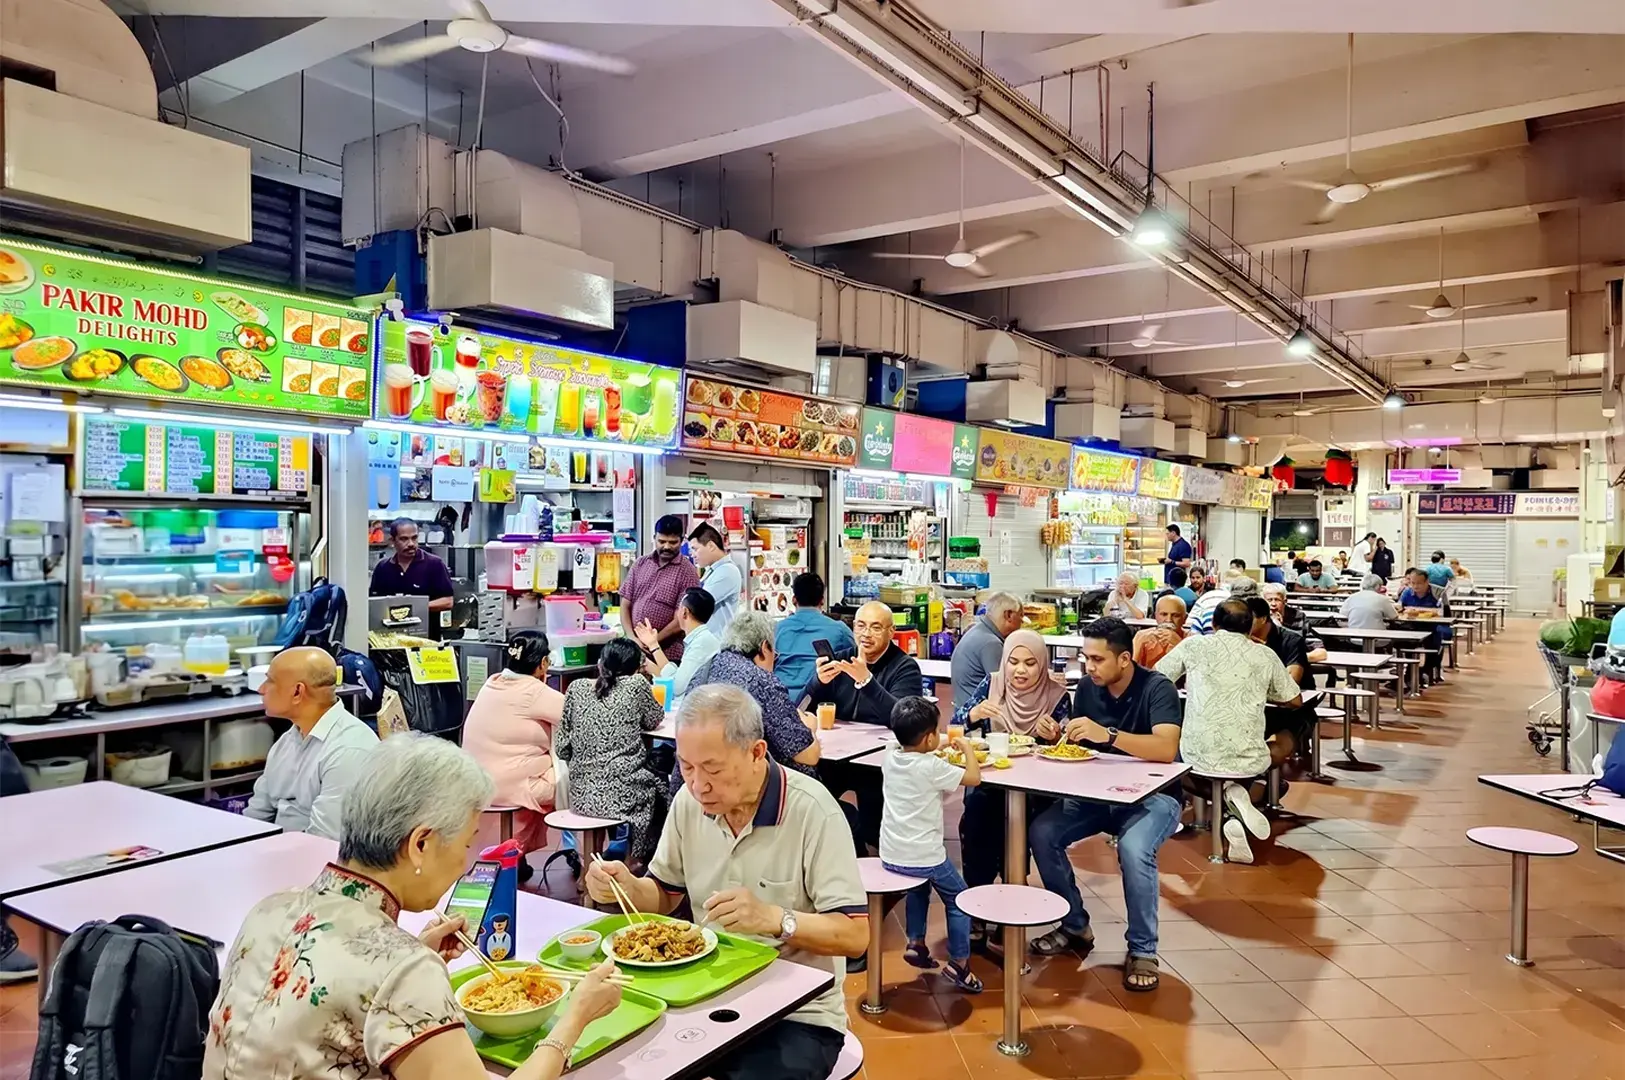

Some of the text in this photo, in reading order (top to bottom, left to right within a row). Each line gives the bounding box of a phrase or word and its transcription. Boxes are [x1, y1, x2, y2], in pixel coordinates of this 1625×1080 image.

[43, 284, 123, 318] PAKIR
[133, 299, 208, 330] MOHD
[78, 319, 178, 346] DELIGHTS
